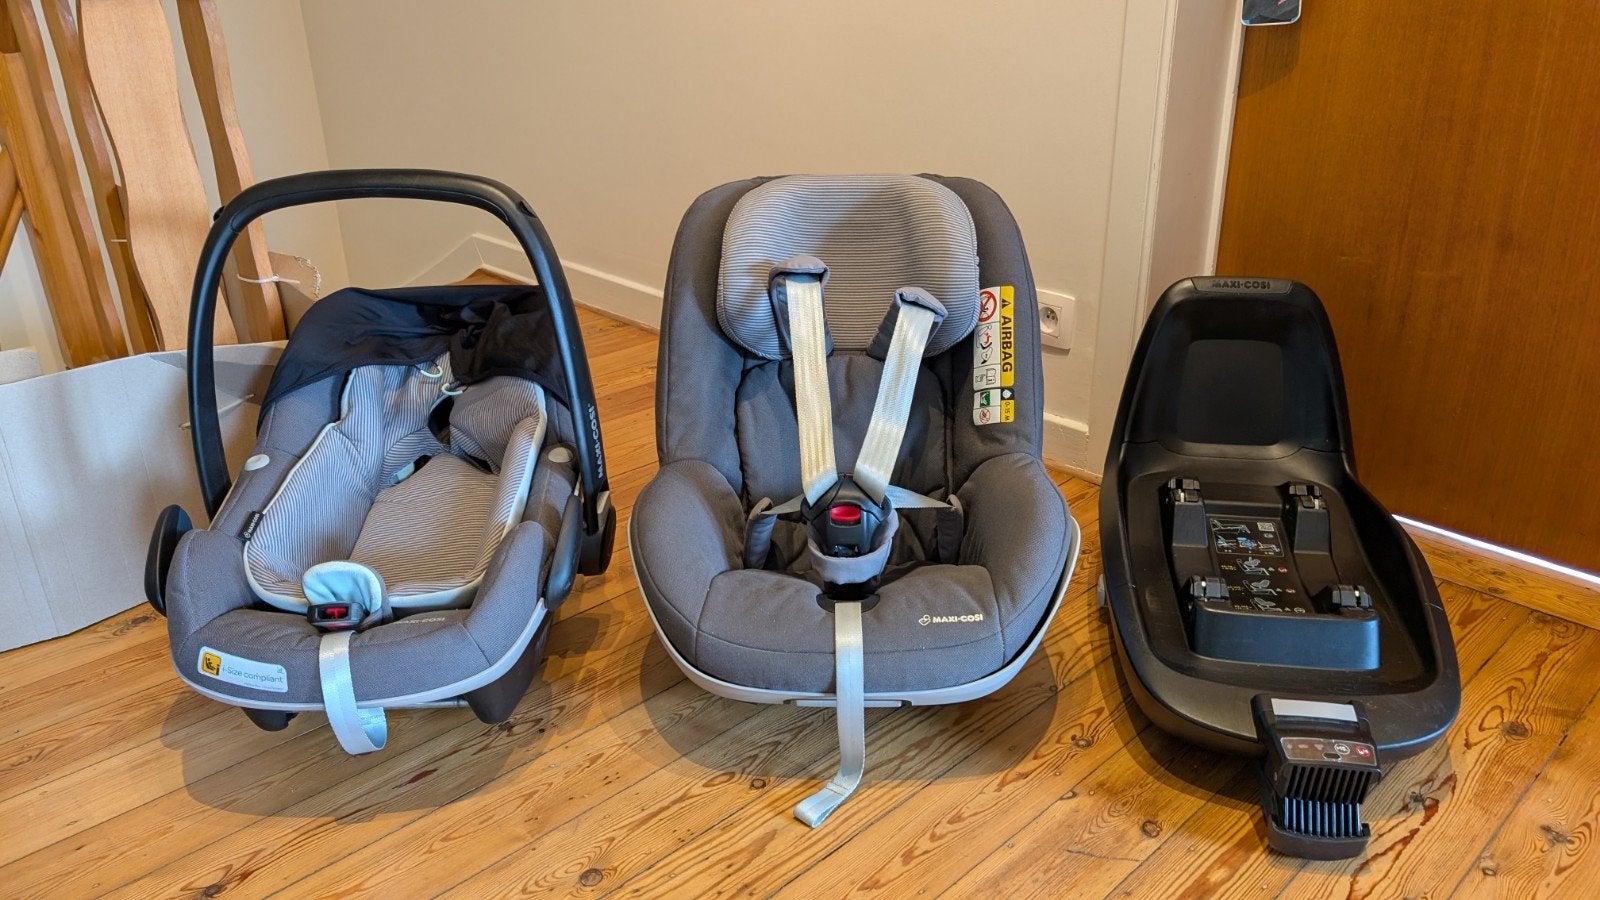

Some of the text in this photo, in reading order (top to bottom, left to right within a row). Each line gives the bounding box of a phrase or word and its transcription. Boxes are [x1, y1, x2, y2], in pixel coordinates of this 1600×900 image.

[1212, 280, 1271, 290] MAXI-COSI
[1001, 316, 1013, 373] AIRBAG
[588, 405, 604, 479] MAXI-COSI
[932, 613, 984, 624] MAXI-COSI
[222, 664, 284, 684] i-Size compliant
